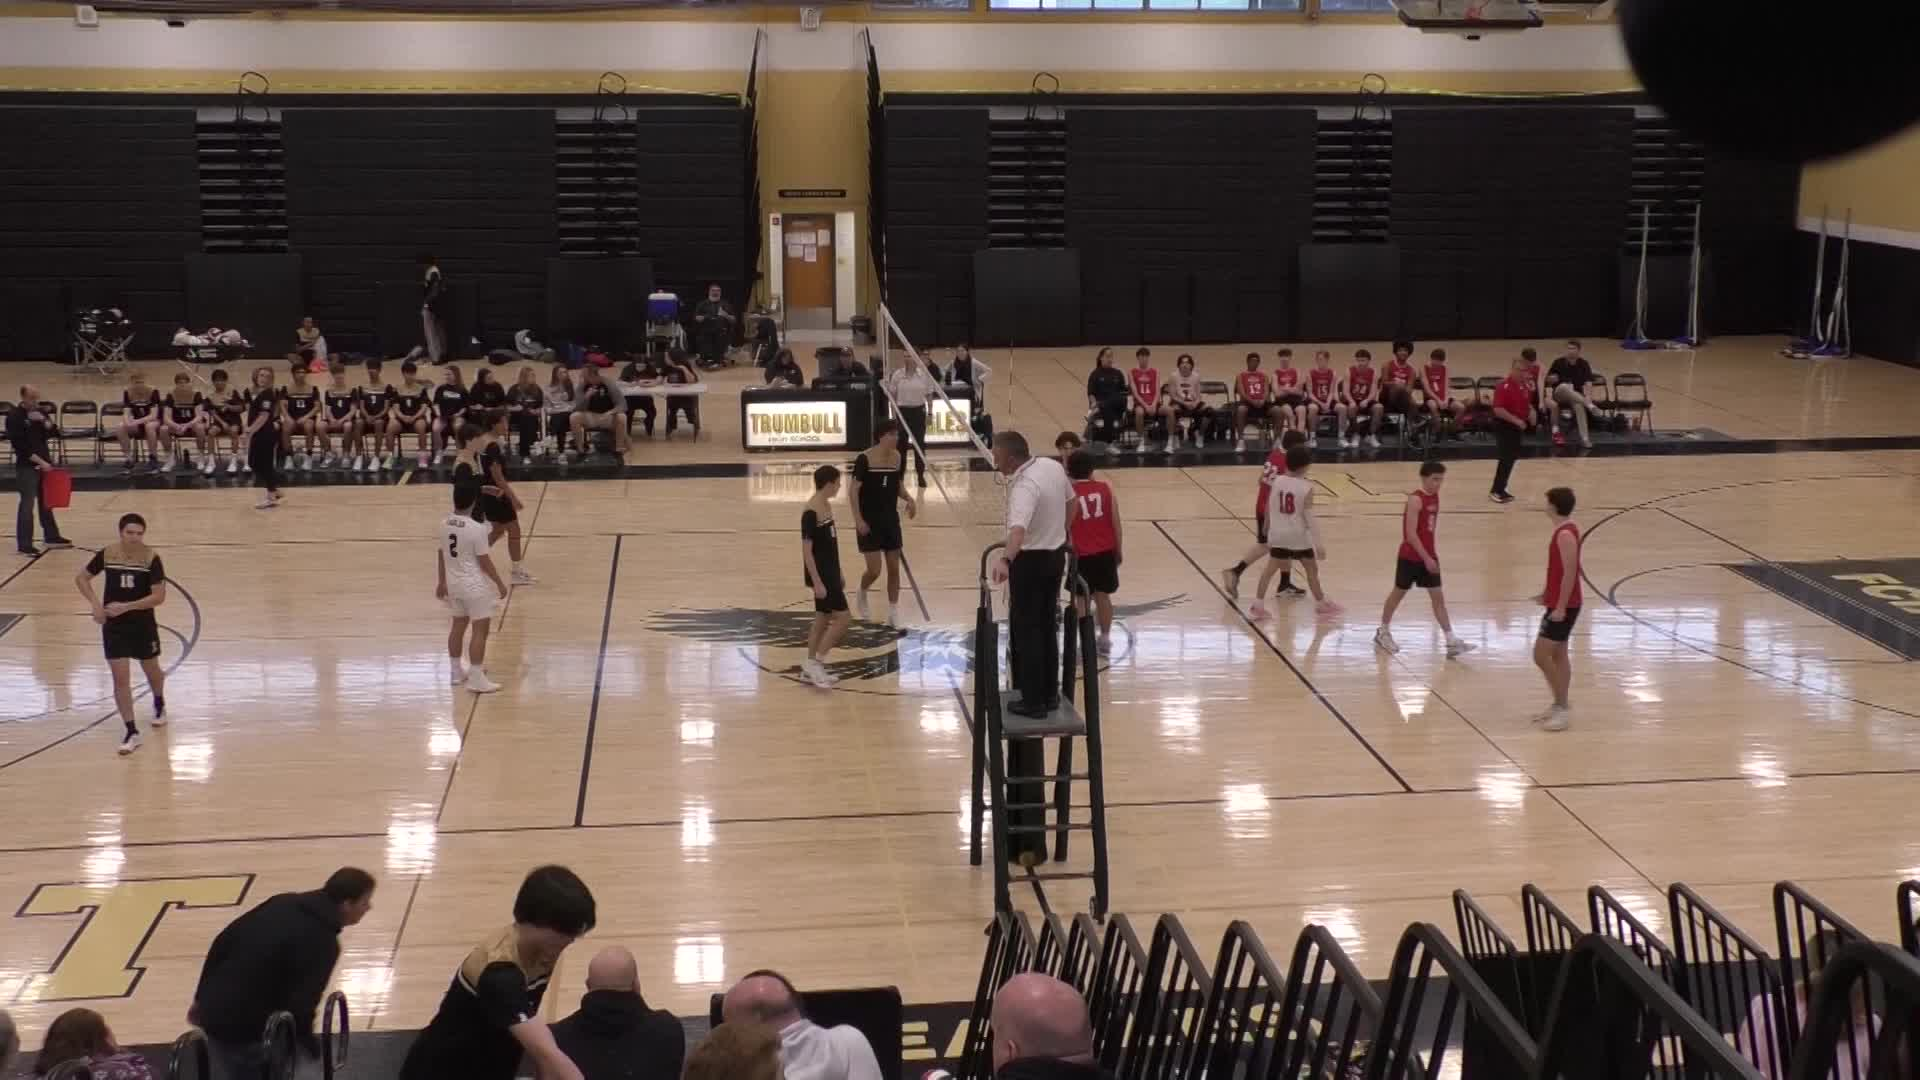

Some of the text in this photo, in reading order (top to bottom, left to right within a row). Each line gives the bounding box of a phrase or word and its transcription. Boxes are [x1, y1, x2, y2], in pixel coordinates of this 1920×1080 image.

[751, 413, 842, 434] TRUMBULL
[1079, 492, 1104, 520] 17
[1279, 490, 1295, 514] 18
[449, 533, 458, 558] 2
[15, 872, 257, 1003] T
